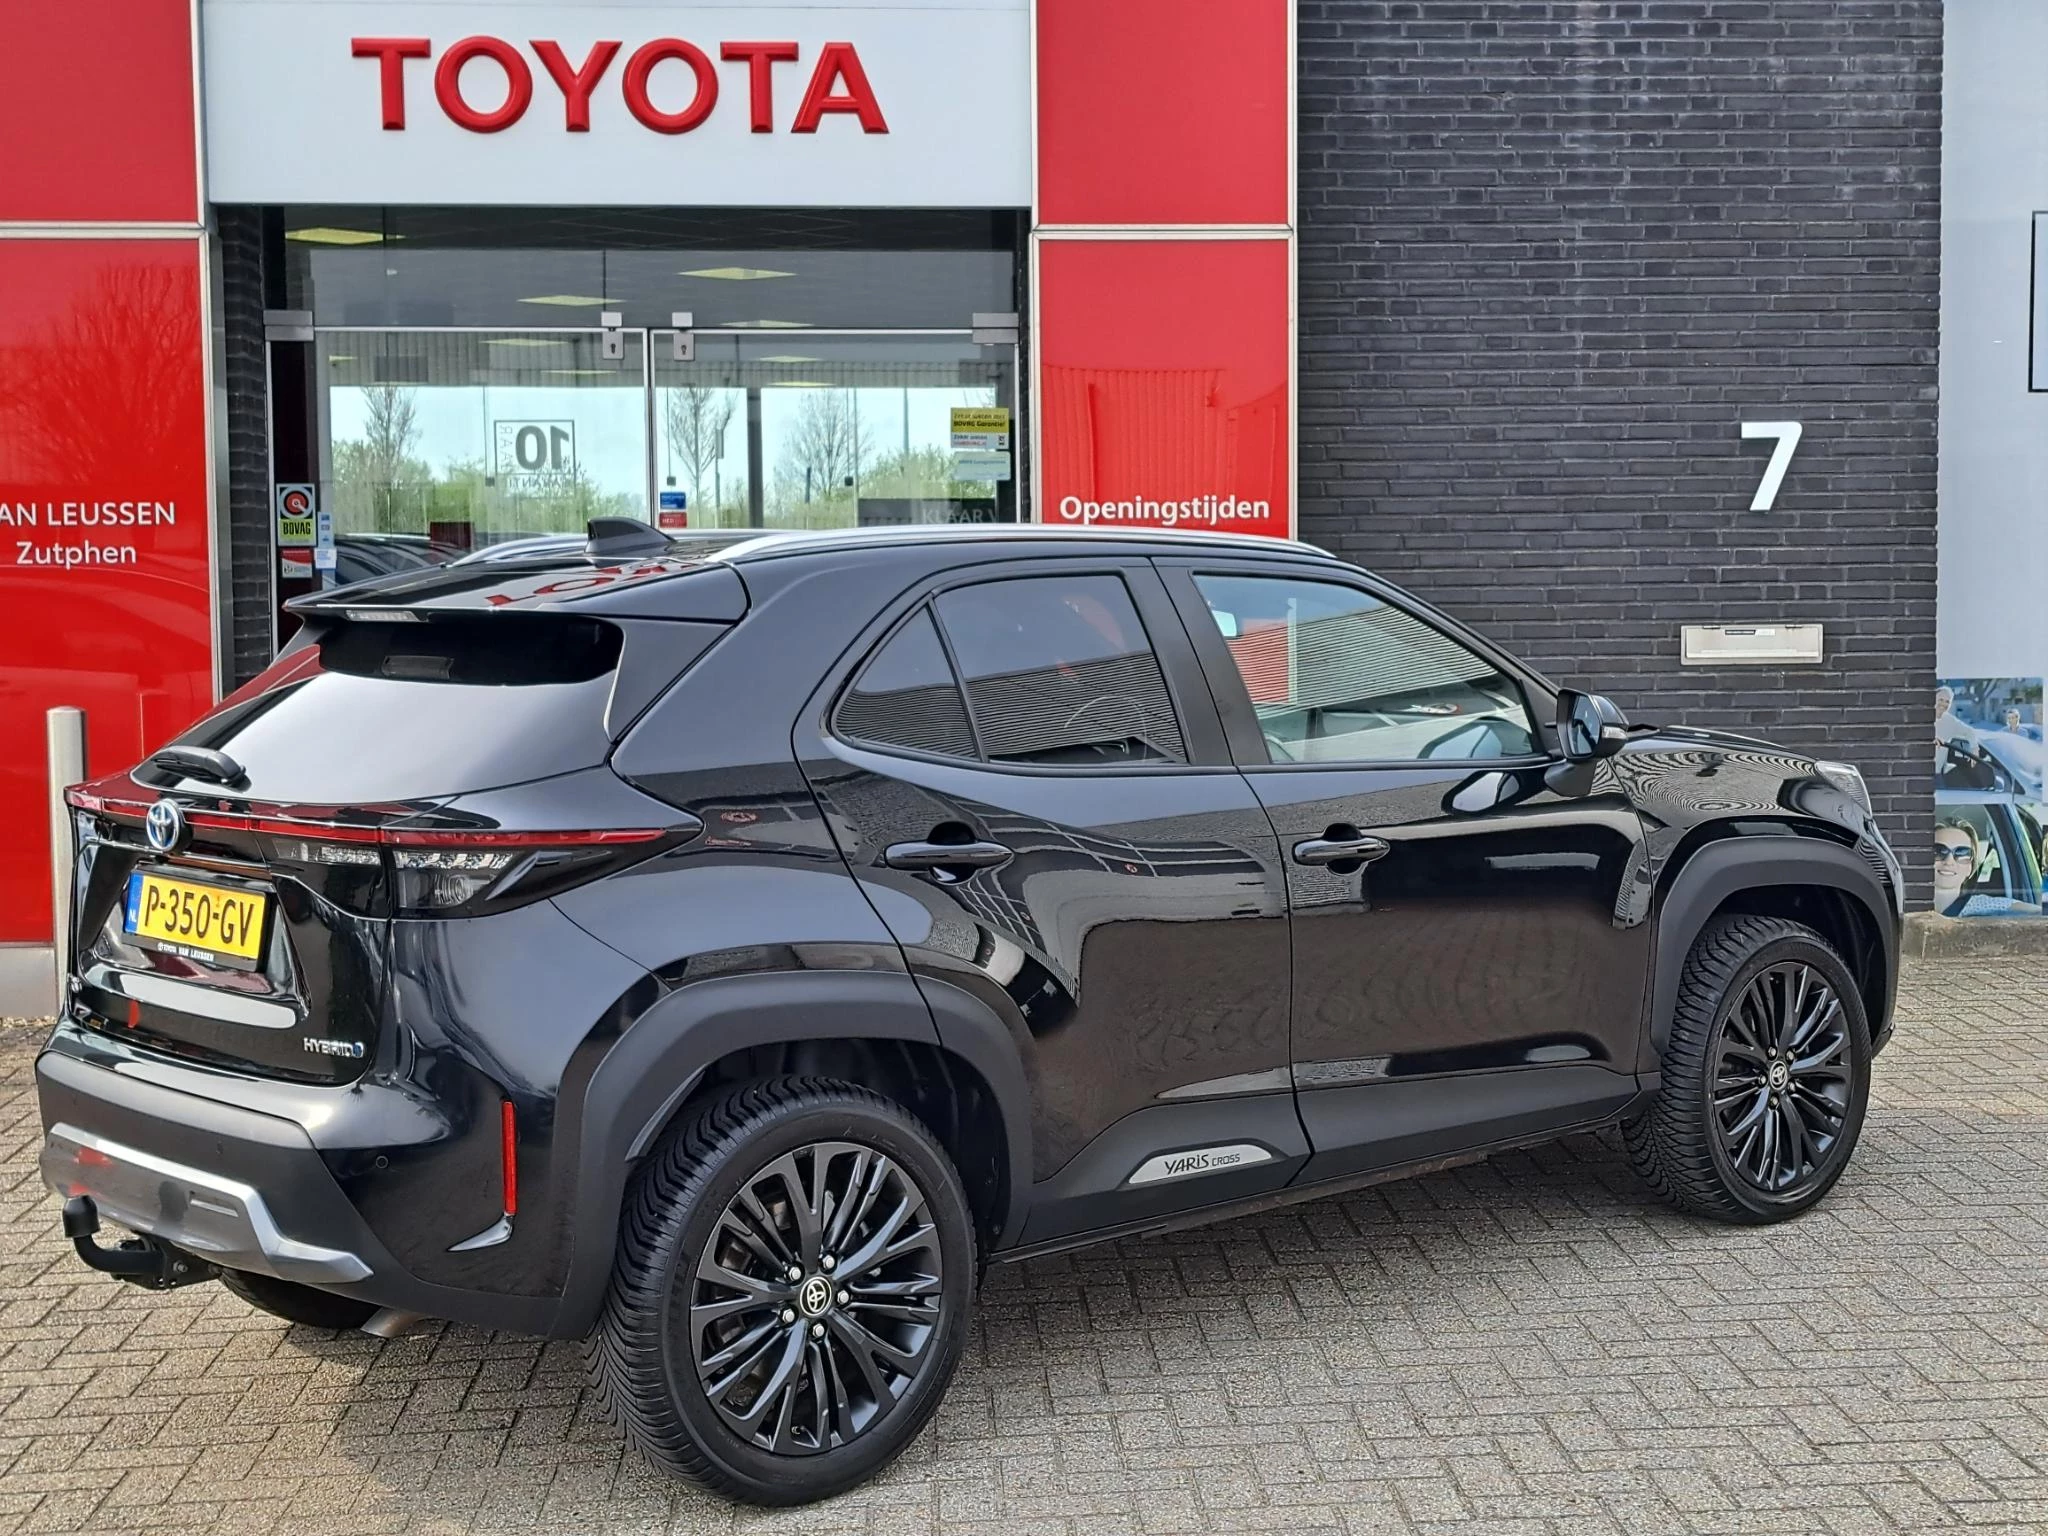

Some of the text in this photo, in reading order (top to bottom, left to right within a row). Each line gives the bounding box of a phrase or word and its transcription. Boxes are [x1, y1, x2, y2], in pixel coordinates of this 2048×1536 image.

[352, 36, 889, 134] TOYOTA
[1741, 421, 1803, 511] 7
[47, 501, 176, 526] LEUSSEN
[1059, 495, 1270, 526] Openingstijden
[283, 521, 311, 535] BOVAG
[16, 539, 137, 570] Zutphen
[128, 908, 137, 923] NL
[144, 884, 255, 948] P-350-GV
[303, 1037, 353, 1057] HYBRID
[1211, 1153, 1241, 1167] CROSS
